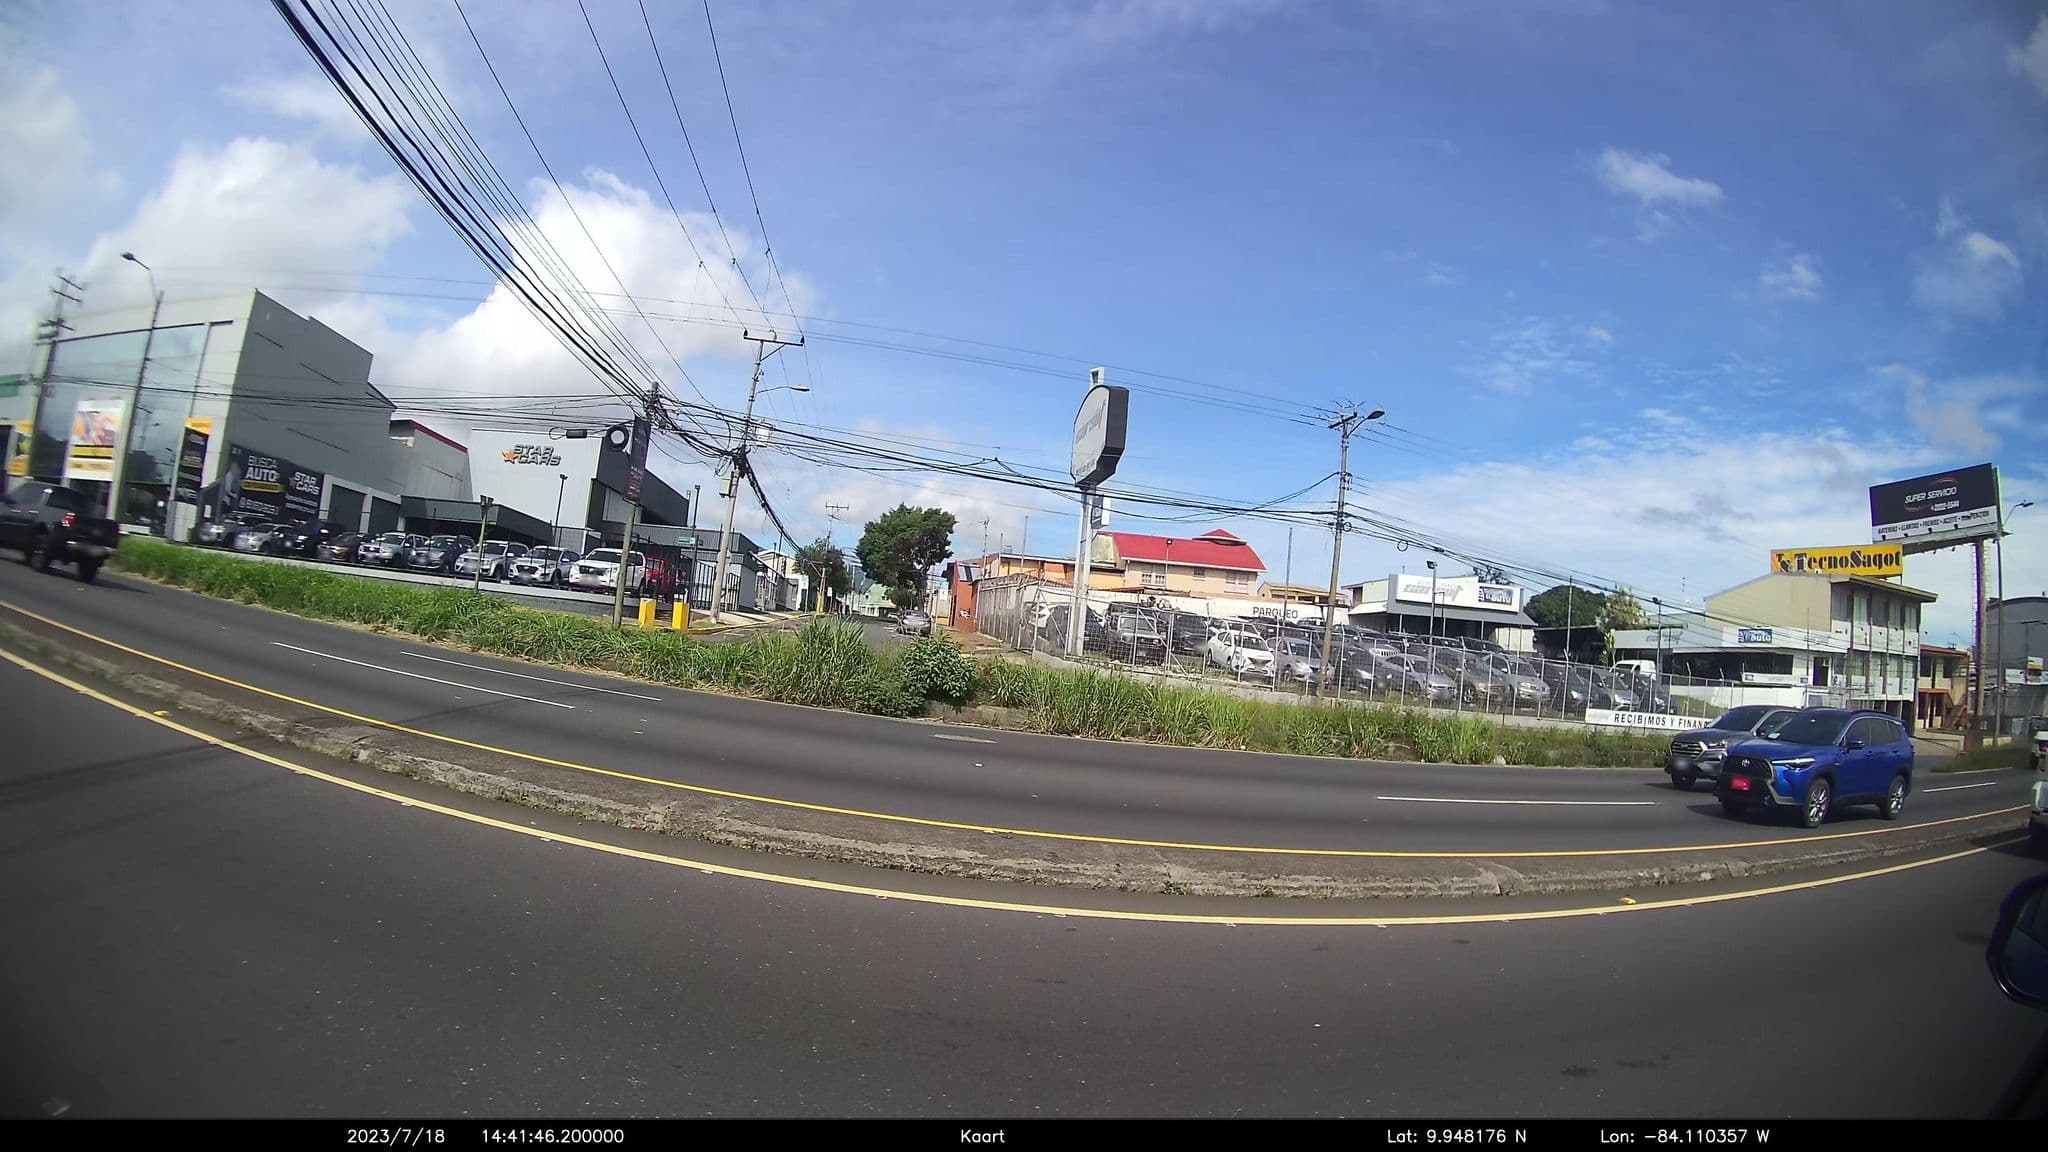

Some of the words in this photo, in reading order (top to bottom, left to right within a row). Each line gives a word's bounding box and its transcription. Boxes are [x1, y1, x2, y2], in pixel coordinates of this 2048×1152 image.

[514, 444, 554, 457] STAR
[247, 455, 279, 469] BUSCA
[518, 453, 561, 466] CARS
[294, 472, 317, 486] STAR
[295, 481, 320, 496] CARS
[1904, 492, 1926, 504] SUPER
[1926, 486, 1958, 501] SERVICIO
[1252, 606, 1298, 619] PARQUEO
[1614, 713, 1666, 727] RECIBIMOS
[1670, 717, 1675, 727] Y
